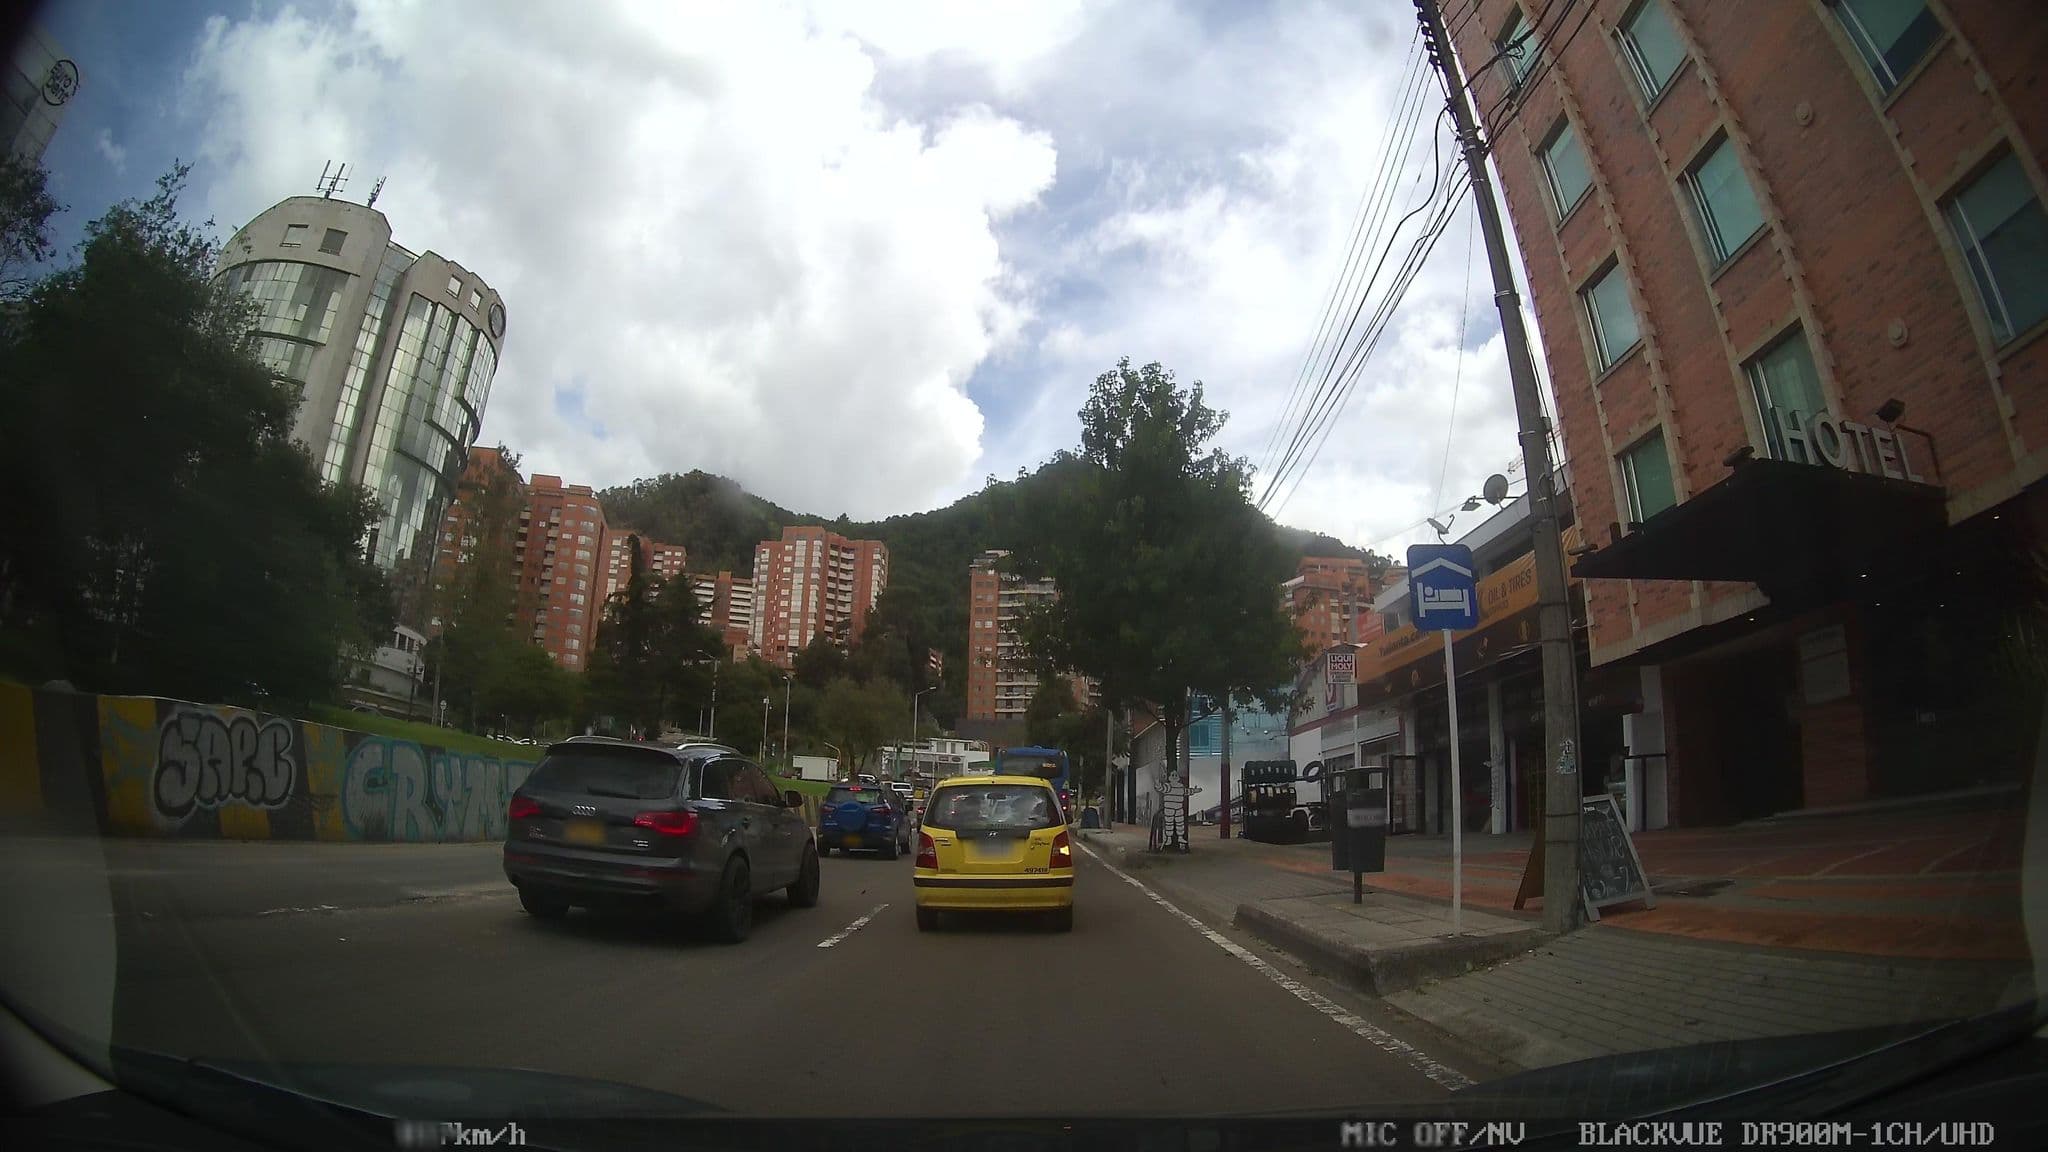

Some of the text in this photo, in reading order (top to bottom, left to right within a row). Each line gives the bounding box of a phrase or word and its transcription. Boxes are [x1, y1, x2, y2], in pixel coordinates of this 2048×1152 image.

[1772, 406, 1925, 483] HOTEL
[1488, 569, 1532, 605] OIL & TIRES
[1330, 655, 1353, 663] LIQUI
[1330, 662, 1353, 670] MOLY
